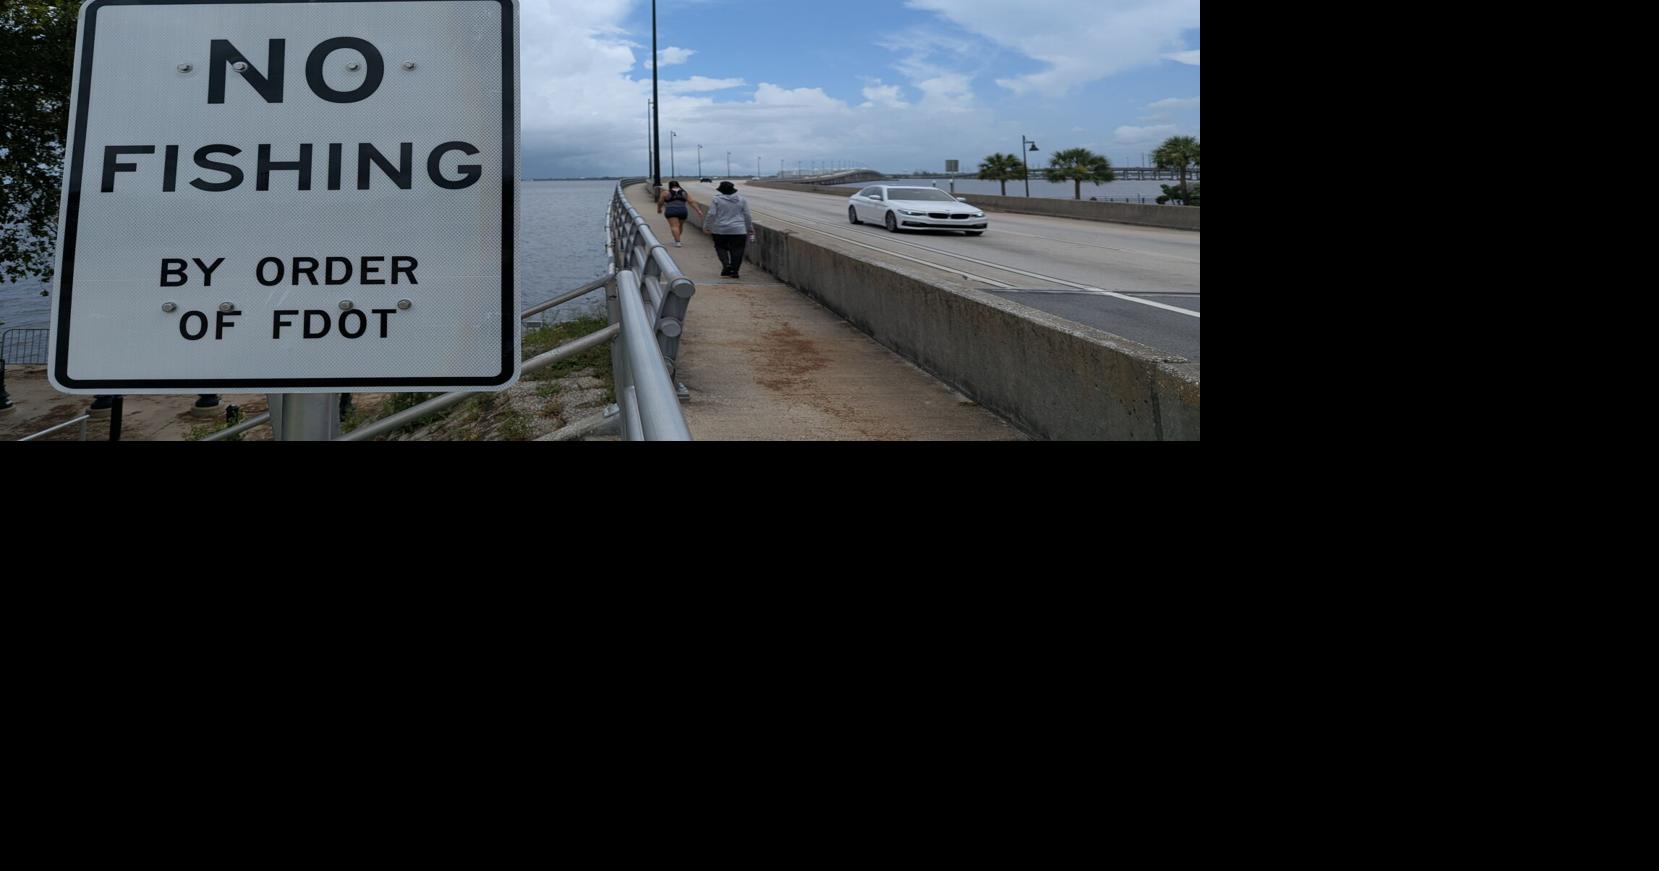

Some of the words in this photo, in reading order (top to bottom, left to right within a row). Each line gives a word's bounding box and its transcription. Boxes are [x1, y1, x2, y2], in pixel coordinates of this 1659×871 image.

[207, 36, 385, 105] NO
[100, 140, 483, 193] FISHING
[159, 257, 226, 288] BY
[255, 255, 419, 287] ORDER
[178, 309, 243, 341] OF
[271, 308, 398, 340] FDOT
